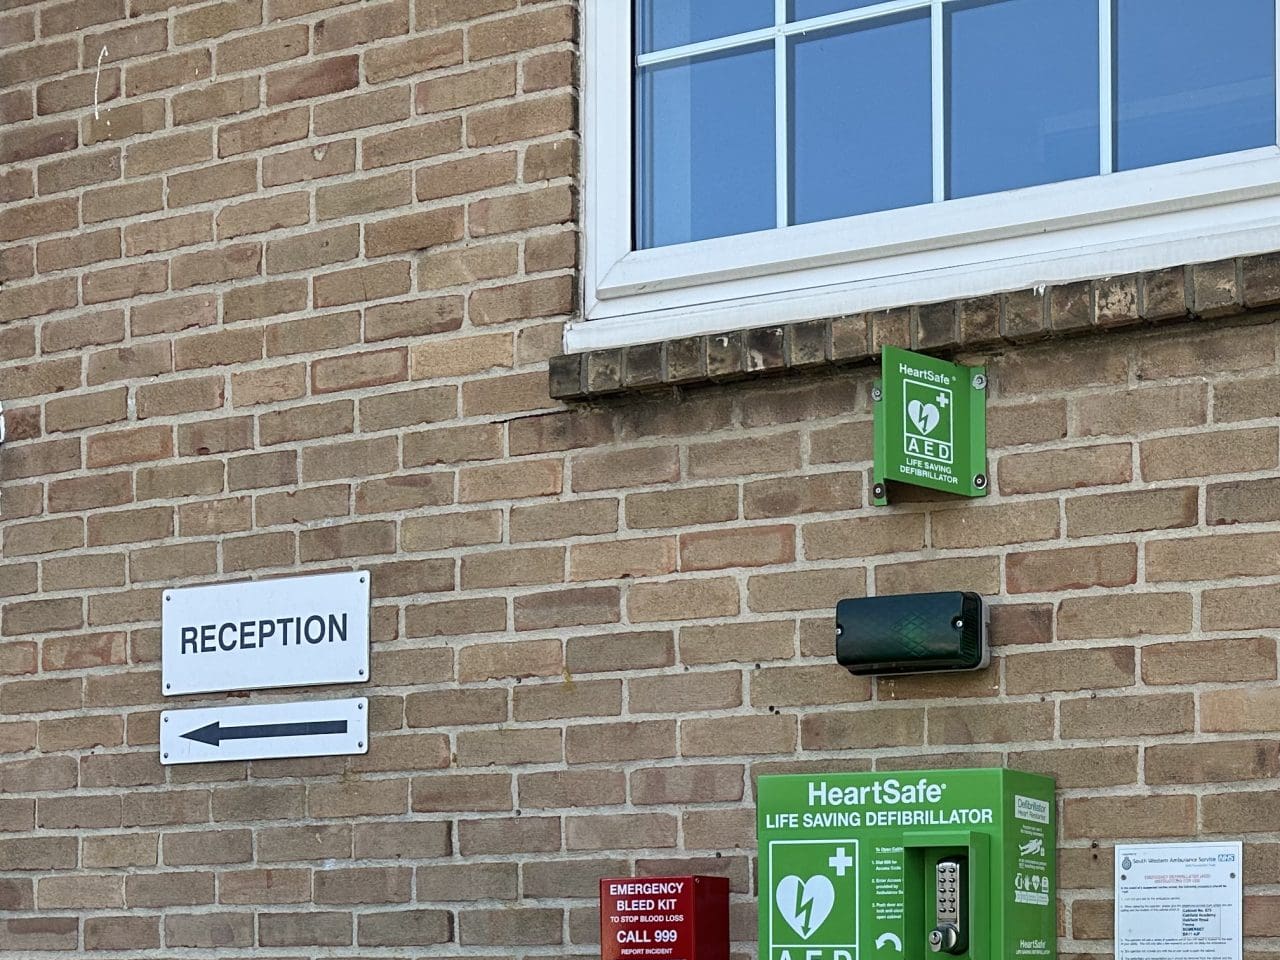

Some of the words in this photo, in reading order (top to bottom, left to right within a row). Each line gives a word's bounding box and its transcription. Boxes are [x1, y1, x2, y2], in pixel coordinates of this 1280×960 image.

[899, 363, 950, 384] HeartSafe
[900, 465, 958, 484] DEFIBRILLATOR
[906, 458, 922, 468] LIFE
[924, 462, 951, 474] SAVING
[181, 613, 347, 654] RECEPTION
[807, 779, 943, 806] HeartSafe
[766, 813, 798, 829] LIFE
[802, 812, 861, 828] SAVING
[865, 808, 993, 826] DEFIBRILLATOR
[610, 883, 684, 895] EMERGENCY
[617, 900, 654, 911] BLEED
[658, 899, 677, 909] KIT
[617, 931, 651, 943] CALL
[654, 930, 677, 942] 999
